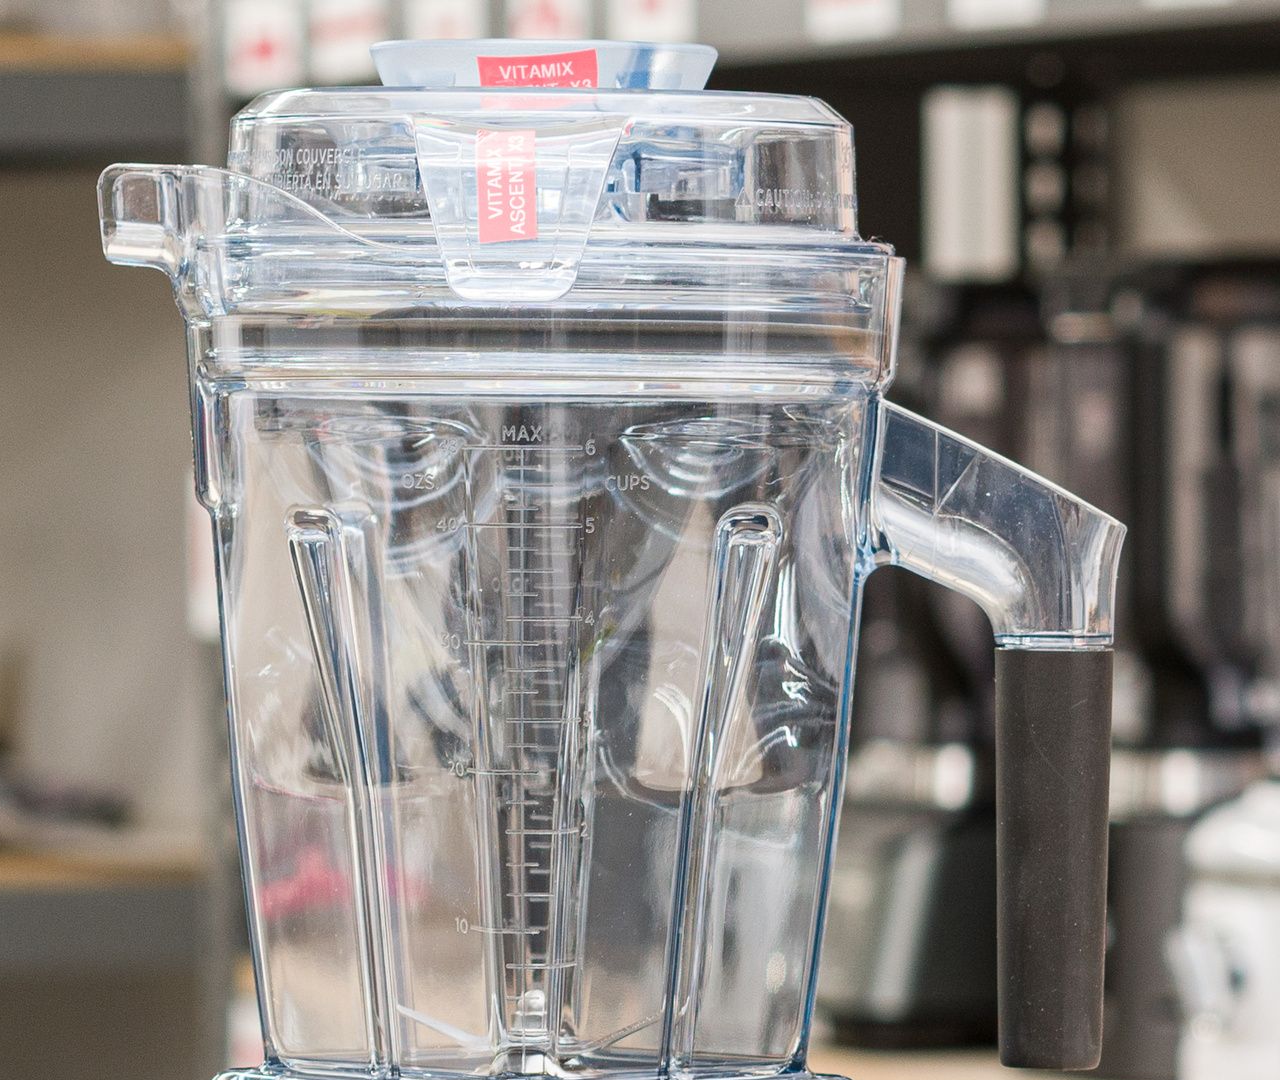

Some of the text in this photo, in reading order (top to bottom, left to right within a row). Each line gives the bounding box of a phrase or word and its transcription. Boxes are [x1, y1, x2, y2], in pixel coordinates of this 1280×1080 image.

[498, 61, 574, 79] VITAMIX
[486, 148, 503, 220] VITAMIX
[508, 135, 526, 234] ASCENT X3
[502, 425, 542, 442] MAX
[585, 439, 596, 456] 6
[605, 475, 650, 492] CUPS
[436, 517, 457, 532] 40
[585, 517, 596, 534] 5
[441, 632, 461, 650] 30
[448, 760, 465, 777] 20
[580, 822, 589, 837] 2
[455, 917, 468, 934] 10
